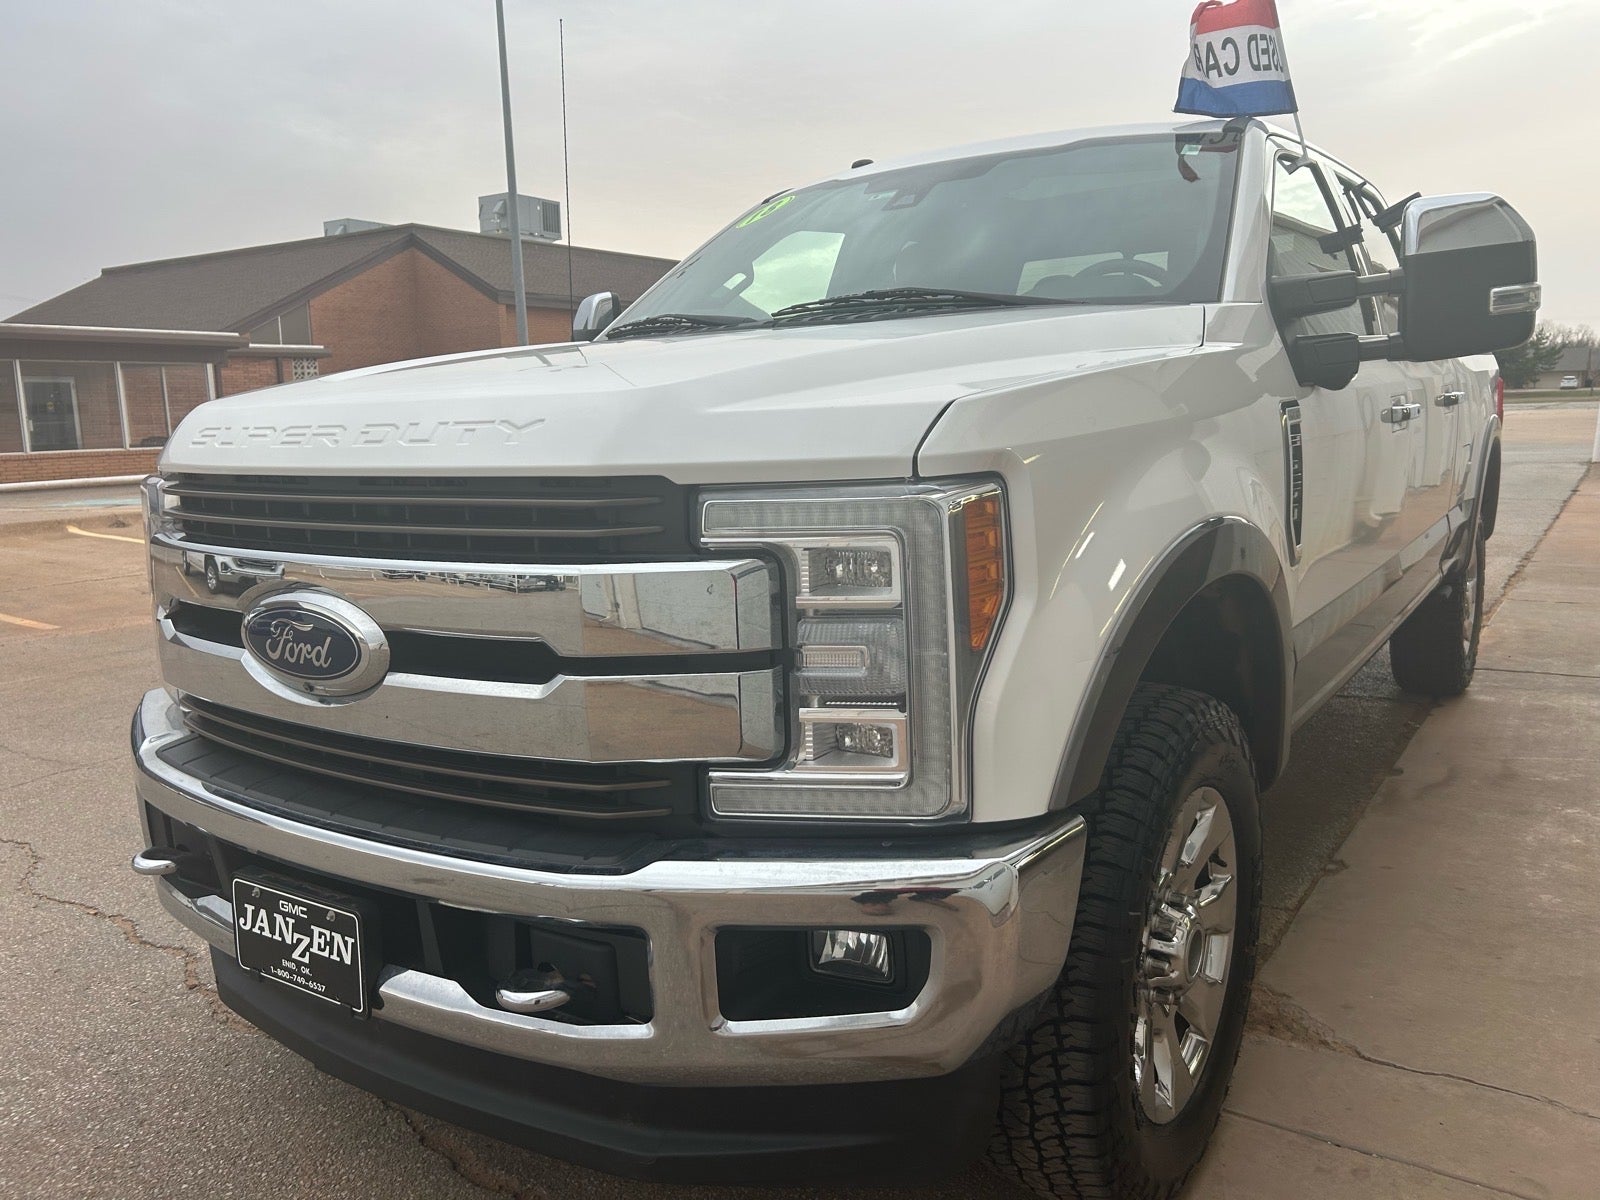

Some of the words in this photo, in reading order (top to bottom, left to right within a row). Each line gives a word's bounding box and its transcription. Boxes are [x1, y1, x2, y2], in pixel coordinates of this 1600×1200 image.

[189, 424, 347, 448] SUPER
[351, 418, 546, 447] DUTY
[266, 618, 332, 668] Ford
[279, 900, 308, 919] GMC
[239, 904, 354, 965] JANZEN
[270, 965, 326, 992] 1-800-749-6537
[282, 958, 298, 972] ENID,
